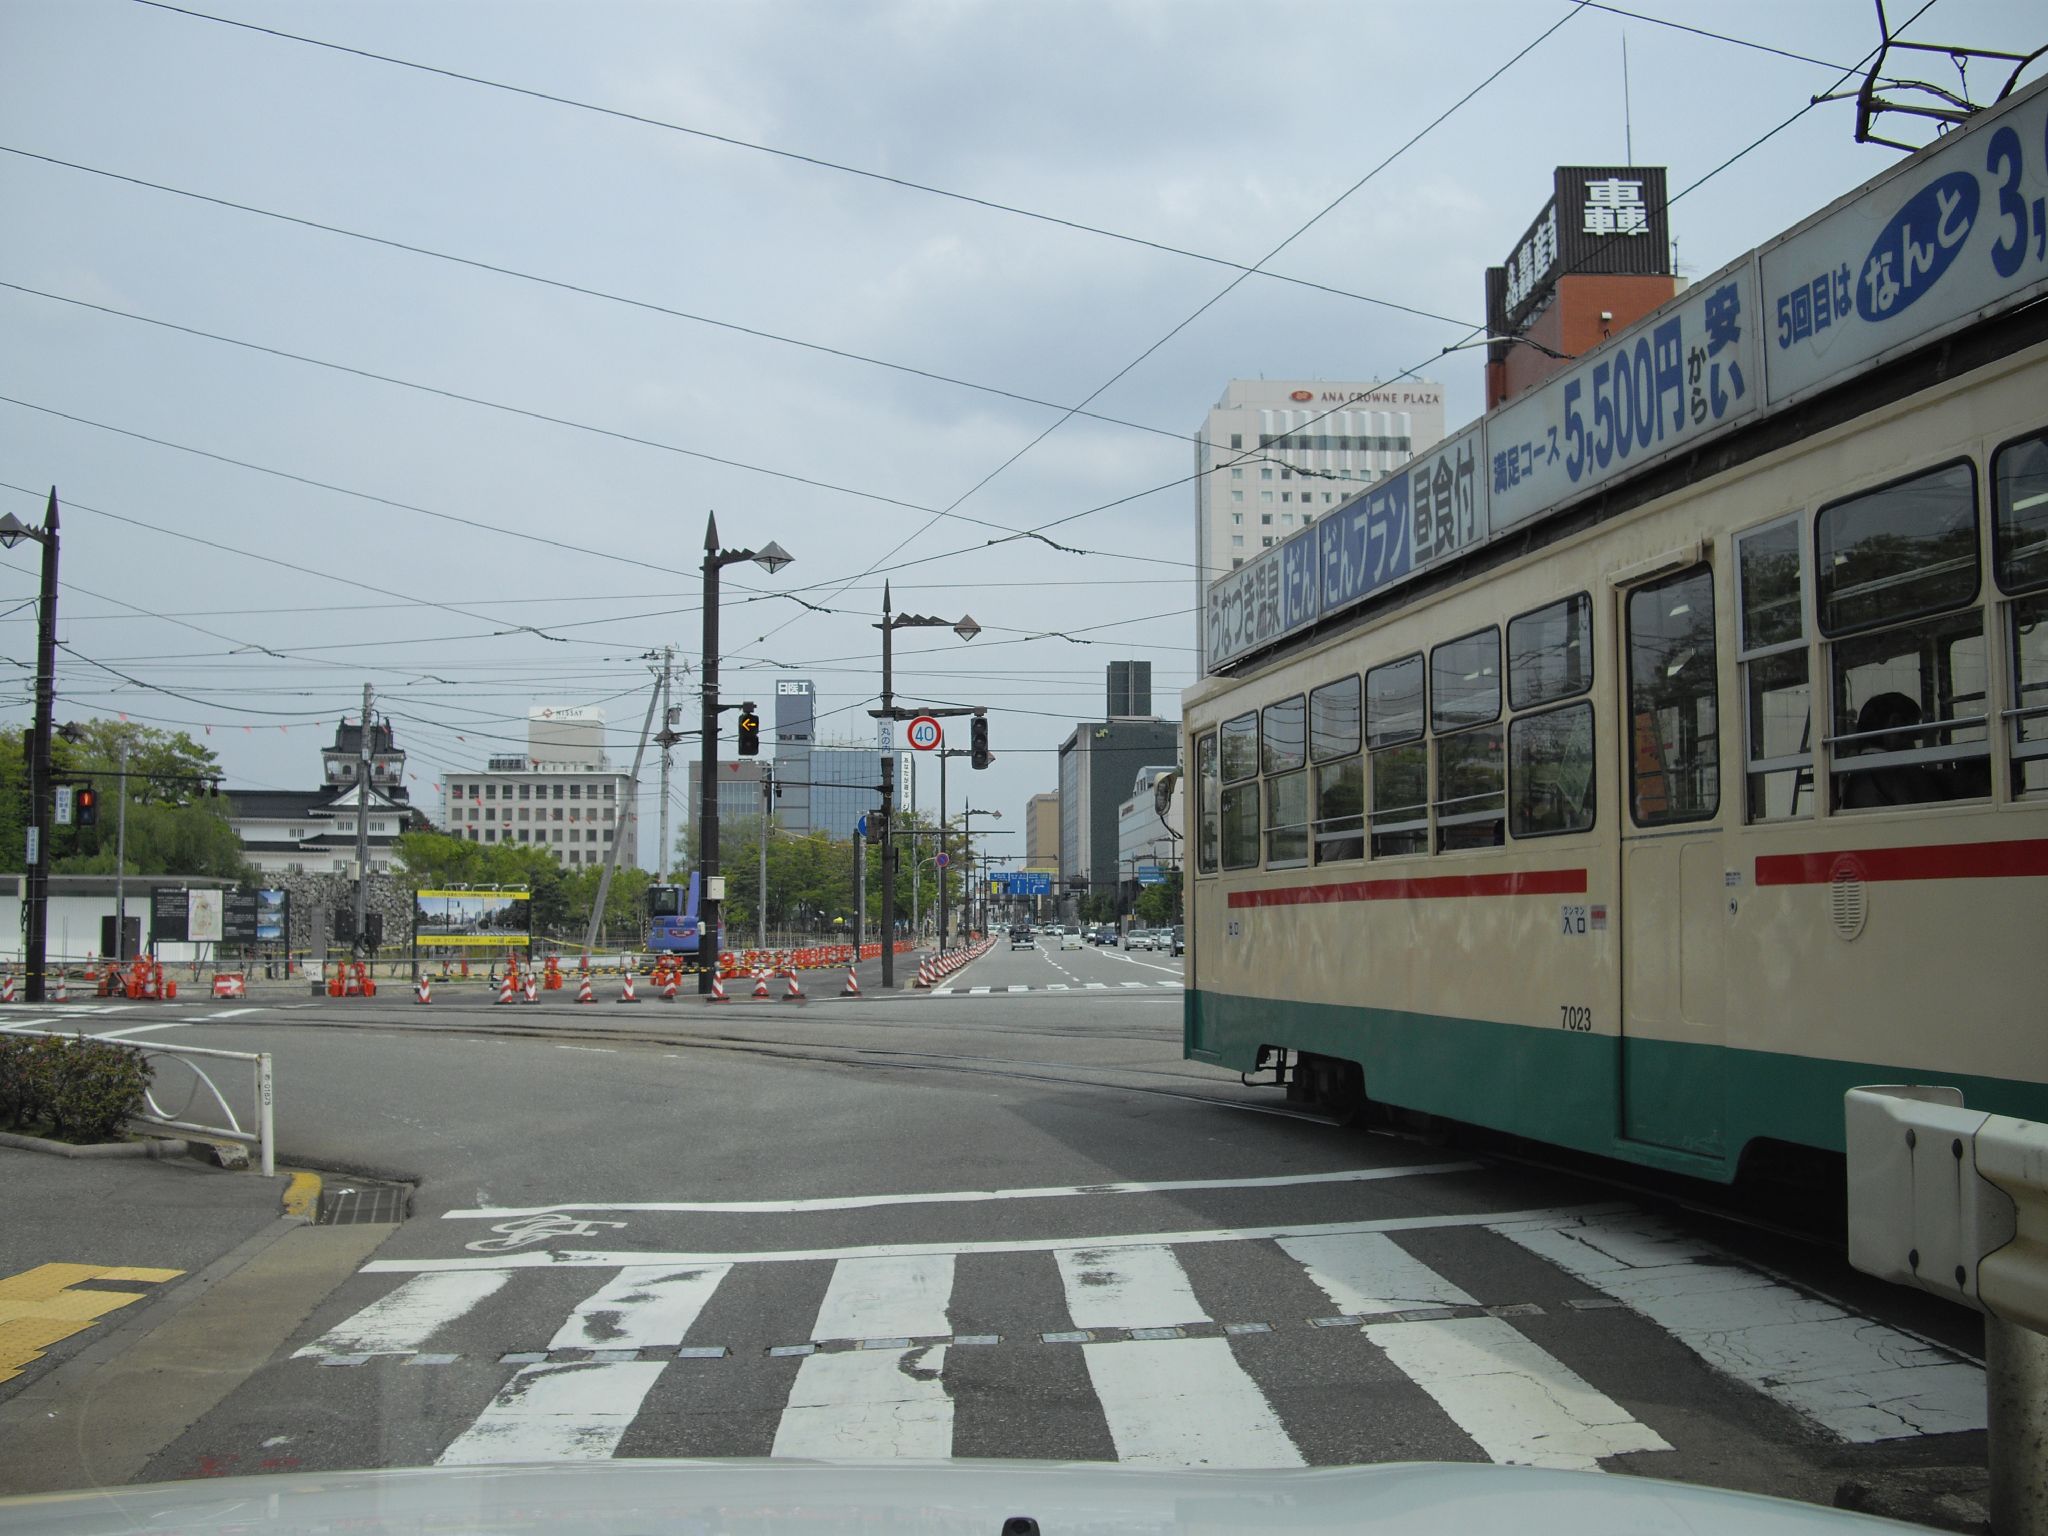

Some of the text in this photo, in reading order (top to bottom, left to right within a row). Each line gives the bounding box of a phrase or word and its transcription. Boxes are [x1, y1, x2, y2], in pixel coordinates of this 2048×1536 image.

[1583, 178, 1649, 235] 轟
[1777, 112, 2048, 349] 5回目は なんと 3,
[1321, 392, 1439, 404] ANA CROWNE PLAZA
[1493, 281, 1746, 495] 満足コース 5,500円 から 安い
[1211, 558, 1281, 662] うなづき温泉
[1413, 439, 1475, 565] 昼食付
[778, 682, 809, 695] 日医工
[881, 727, 891, 755] 丸の内
[915, 726, 935, 742] 40
[1563, 906, 1585, 916] ワンマン
[1563, 917, 1586, 934] 入口
[1560, 1005, 1592, 1031] 7023
